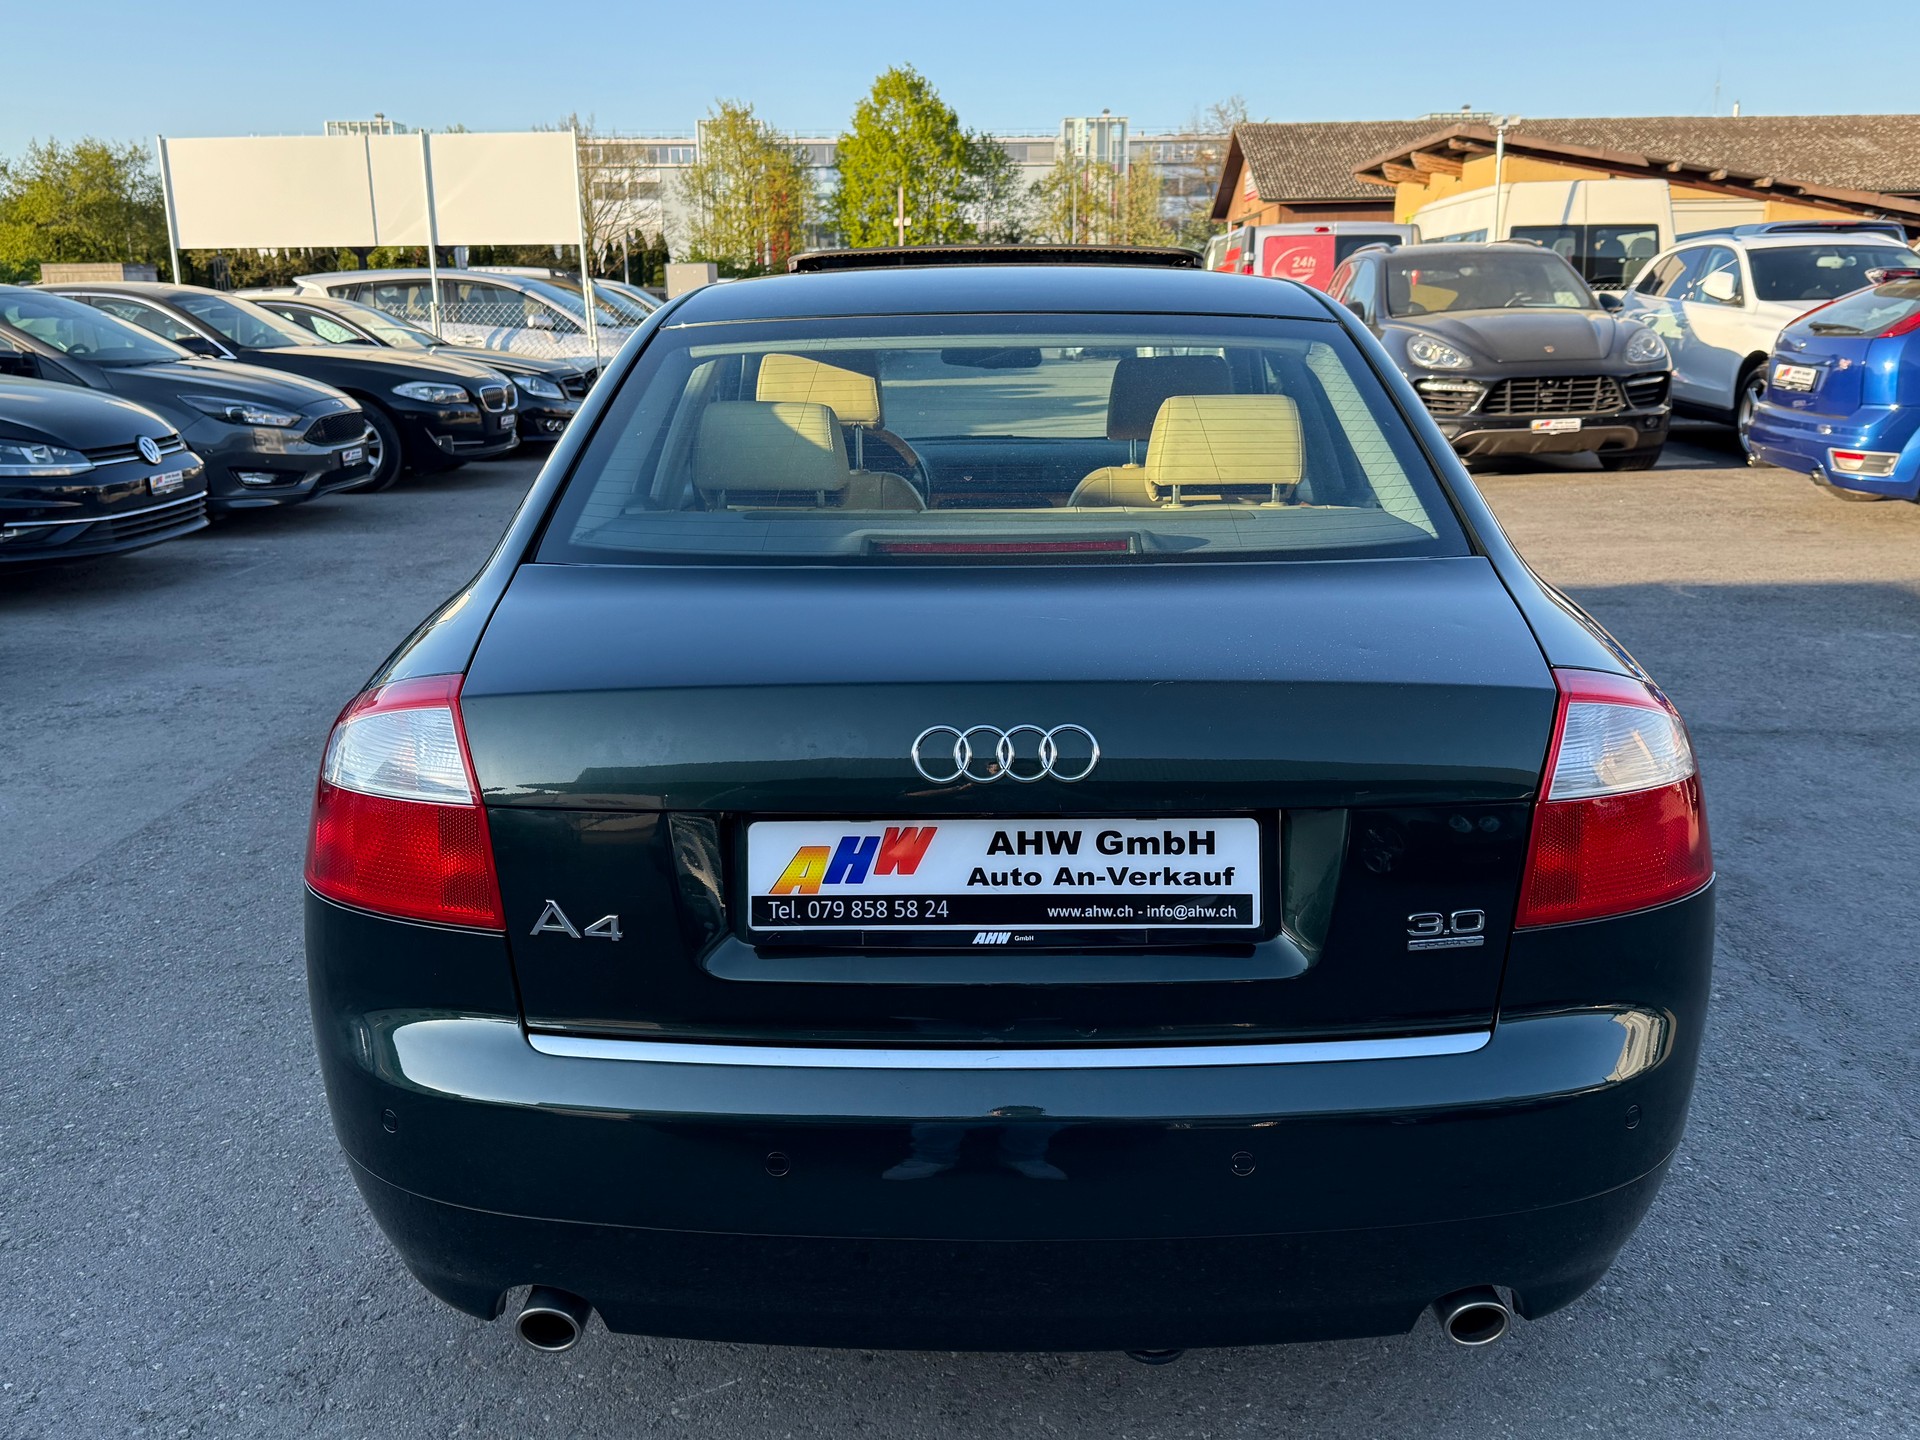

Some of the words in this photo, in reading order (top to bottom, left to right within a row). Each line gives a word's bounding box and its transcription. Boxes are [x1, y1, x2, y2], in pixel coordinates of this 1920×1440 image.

[1291, 255, 1317, 268] 24h
[986, 830, 1082, 856] AHW
[1095, 830, 1216, 856] GmbH
[768, 826, 938, 895] AHW
[966, 866, 1043, 887] Auto
[1053, 866, 1236, 887] An-Verkauf
[768, 901, 801, 919] Tel.
[807, 900, 845, 919] 079
[851, 900, 888, 919] 858
[894, 900, 919, 919] 58
[925, 900, 949, 918] 24
[1047, 904, 1134, 918] www.ahw.ch
[1146, 904, 1237, 921] info@ahw.ch
[529, 899, 624, 942] A4
[1407, 909, 1486, 936] 3.0
[972, 931, 1012, 945] AHW
[1014, 934, 1034, 942] GmbH
